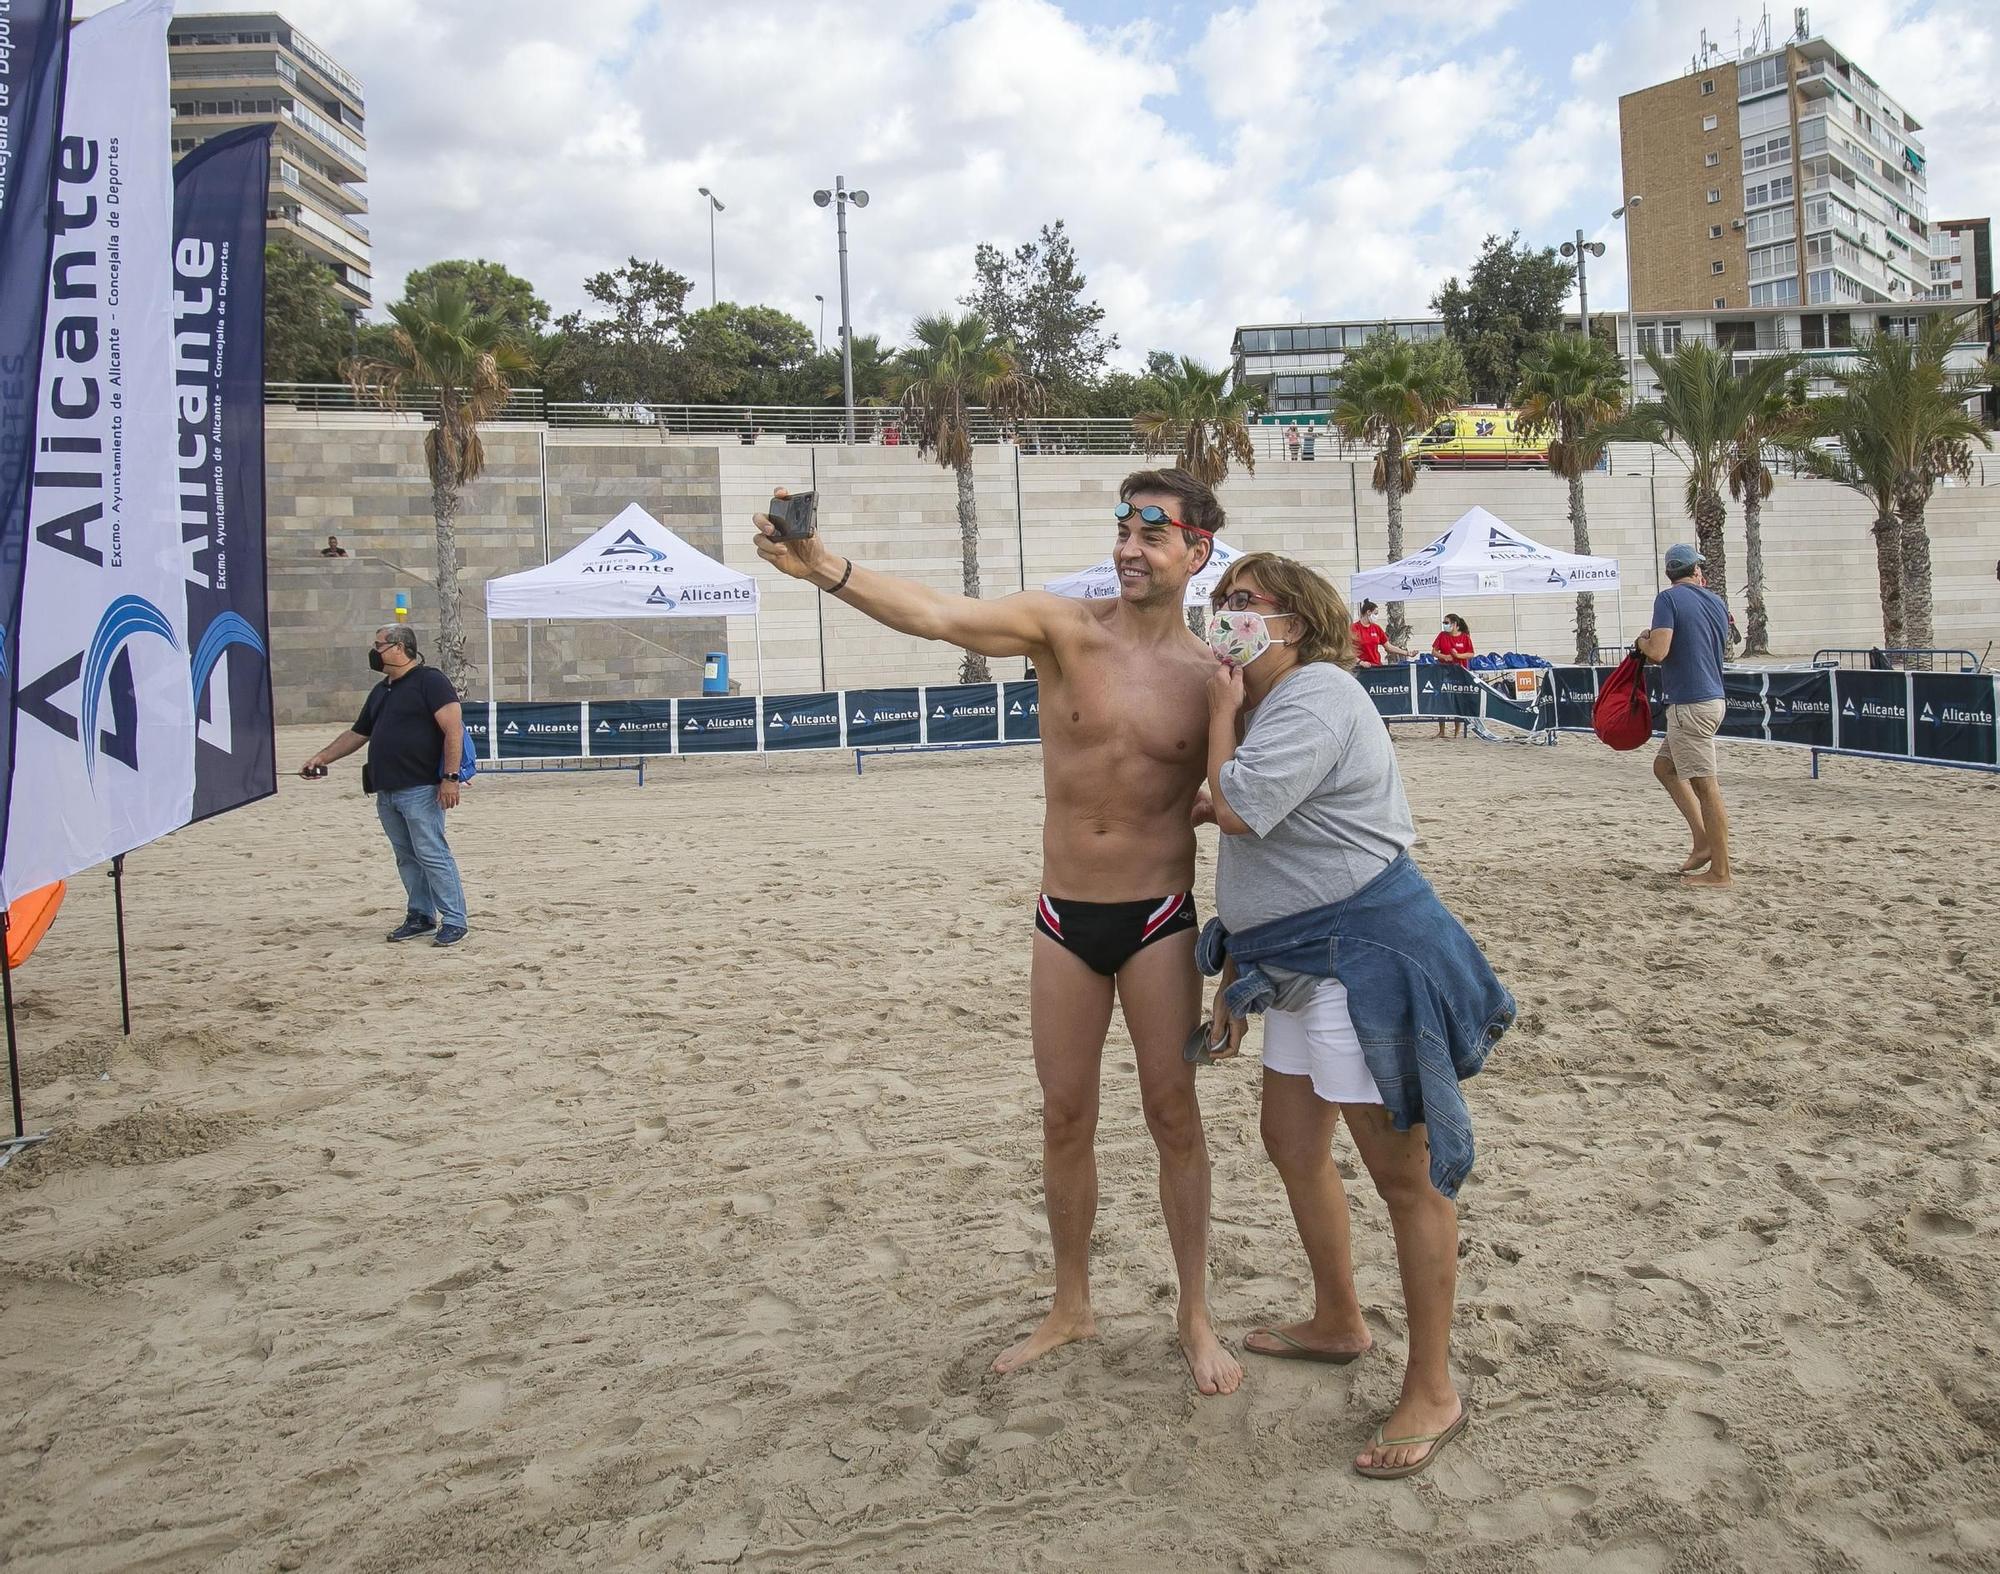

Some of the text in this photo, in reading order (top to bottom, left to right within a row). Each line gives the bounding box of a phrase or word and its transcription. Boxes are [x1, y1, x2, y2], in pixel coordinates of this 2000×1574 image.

[106, 137, 122, 205] Deportes
[106, 211, 119, 228] de
[107, 234, 121, 306] Concejalía
[218, 241, 229, 296] Deportes
[216, 300, 225, 315] de
[34, 135, 103, 568] Alicante
[214, 319, 225, 378] Concejalía
[108, 327, 122, 387] Alicante
[110, 392, 122, 409] de
[212, 395, 223, 443] Alicante
[212, 447, 222, 462] de
[111, 415, 123, 513] Ayuntamiento
[212, 466, 227, 546] Ayuntamiento
[111, 519, 122, 568] Excmo.
[216, 550, 226, 590] Excmo.
[581, 564, 674, 573] Alicante
[1569, 569, 1616, 580] Alicante
[1412, 575, 1438, 587] Alicante
[680, 588, 750, 601] Alicante
[1369, 685, 1410, 694] Alicante
[1440, 683, 1480, 693] Alicante
[873, 710, 919, 721] Alicante
[952, 706, 996, 715] Alicante
[1861, 702, 1906, 717] Alicante
[1942, 708, 1992, 723] Alicante
[618, 722, 669, 731] Alicante
[706, 717, 754, 728] Alicante
[791, 714, 838, 725] Alicante
[527, 723, 579, 733] Alicante
